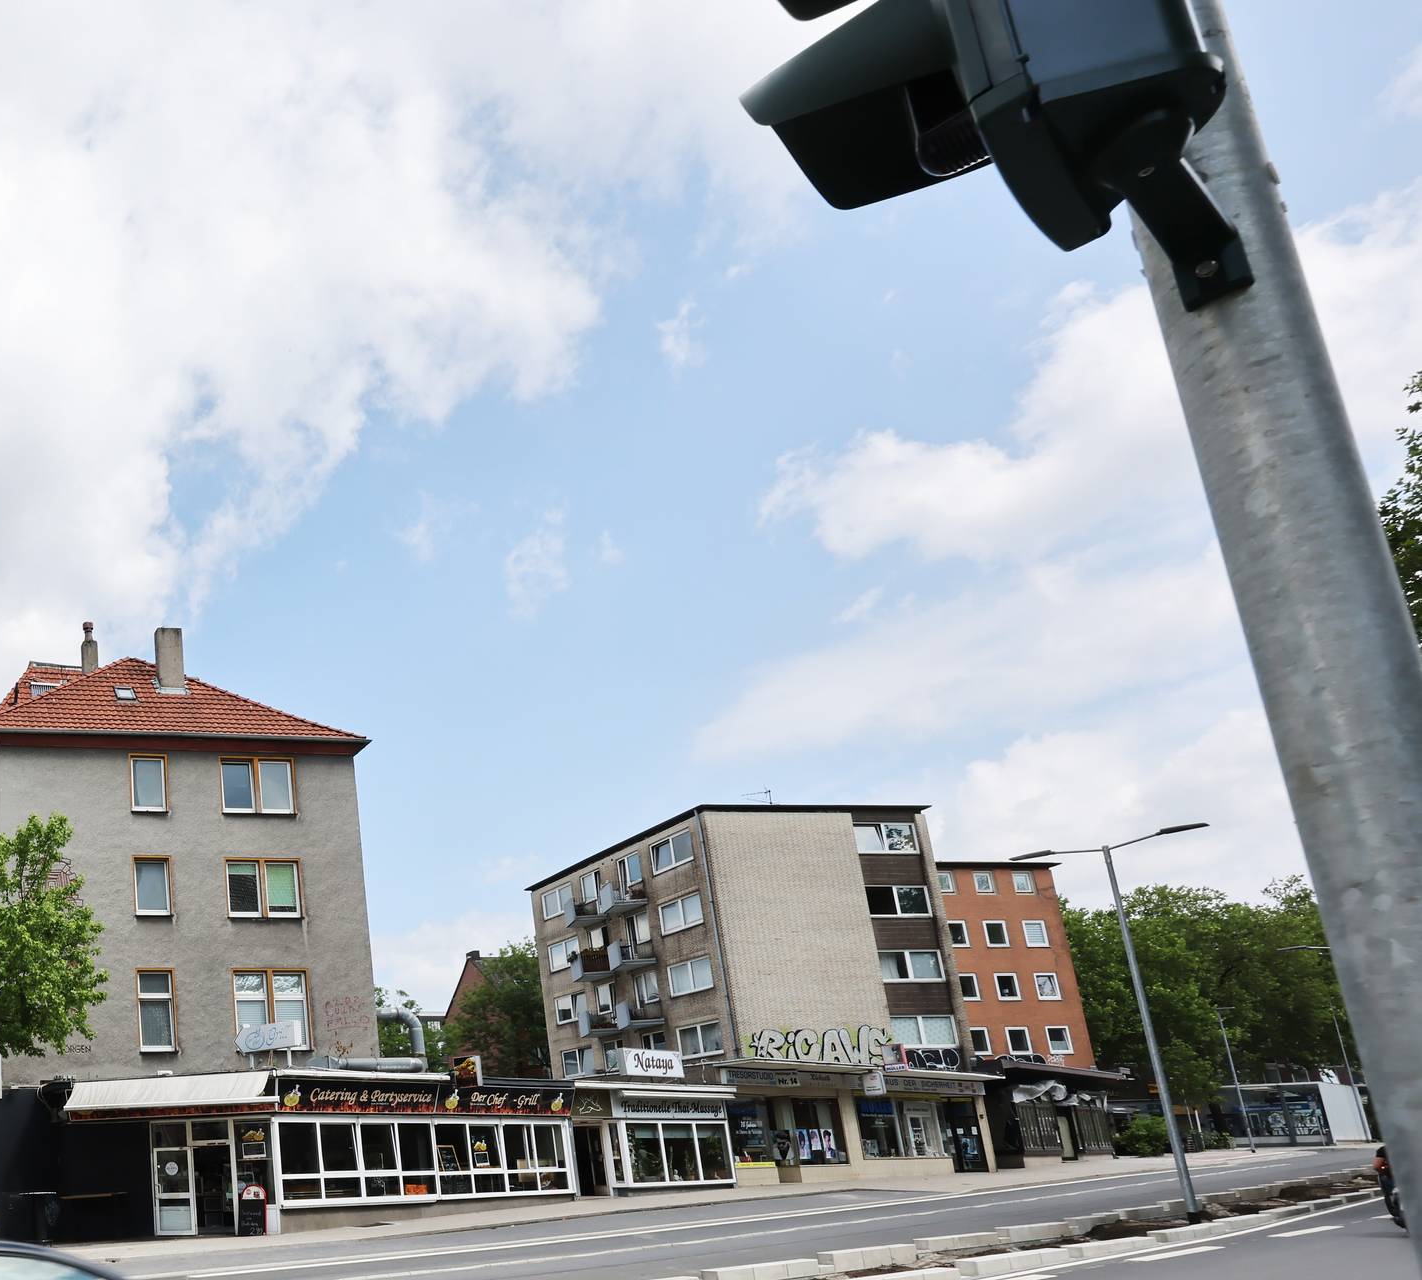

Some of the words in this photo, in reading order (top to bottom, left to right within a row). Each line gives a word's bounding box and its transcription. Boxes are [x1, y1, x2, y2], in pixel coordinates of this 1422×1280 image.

[64, 1044, 92, 1054] ORGEN
[633, 1051, 674, 1075] Nataya
[728, 1070, 774, 1081] TRESORSTUDIO
[885, 1079, 899, 1087] AUS
[310, 1088, 358, 1105] Catering
[359, 1090, 369, 1102] &
[371, 1089, 433, 1107] Partyservice
[471, 1091, 487, 1102] Der
[487, 1093, 509, 1108] Chef
[621, 1100, 671, 1114] Traditionelle
[673, 1100, 723, 1117] Thai-Massage
